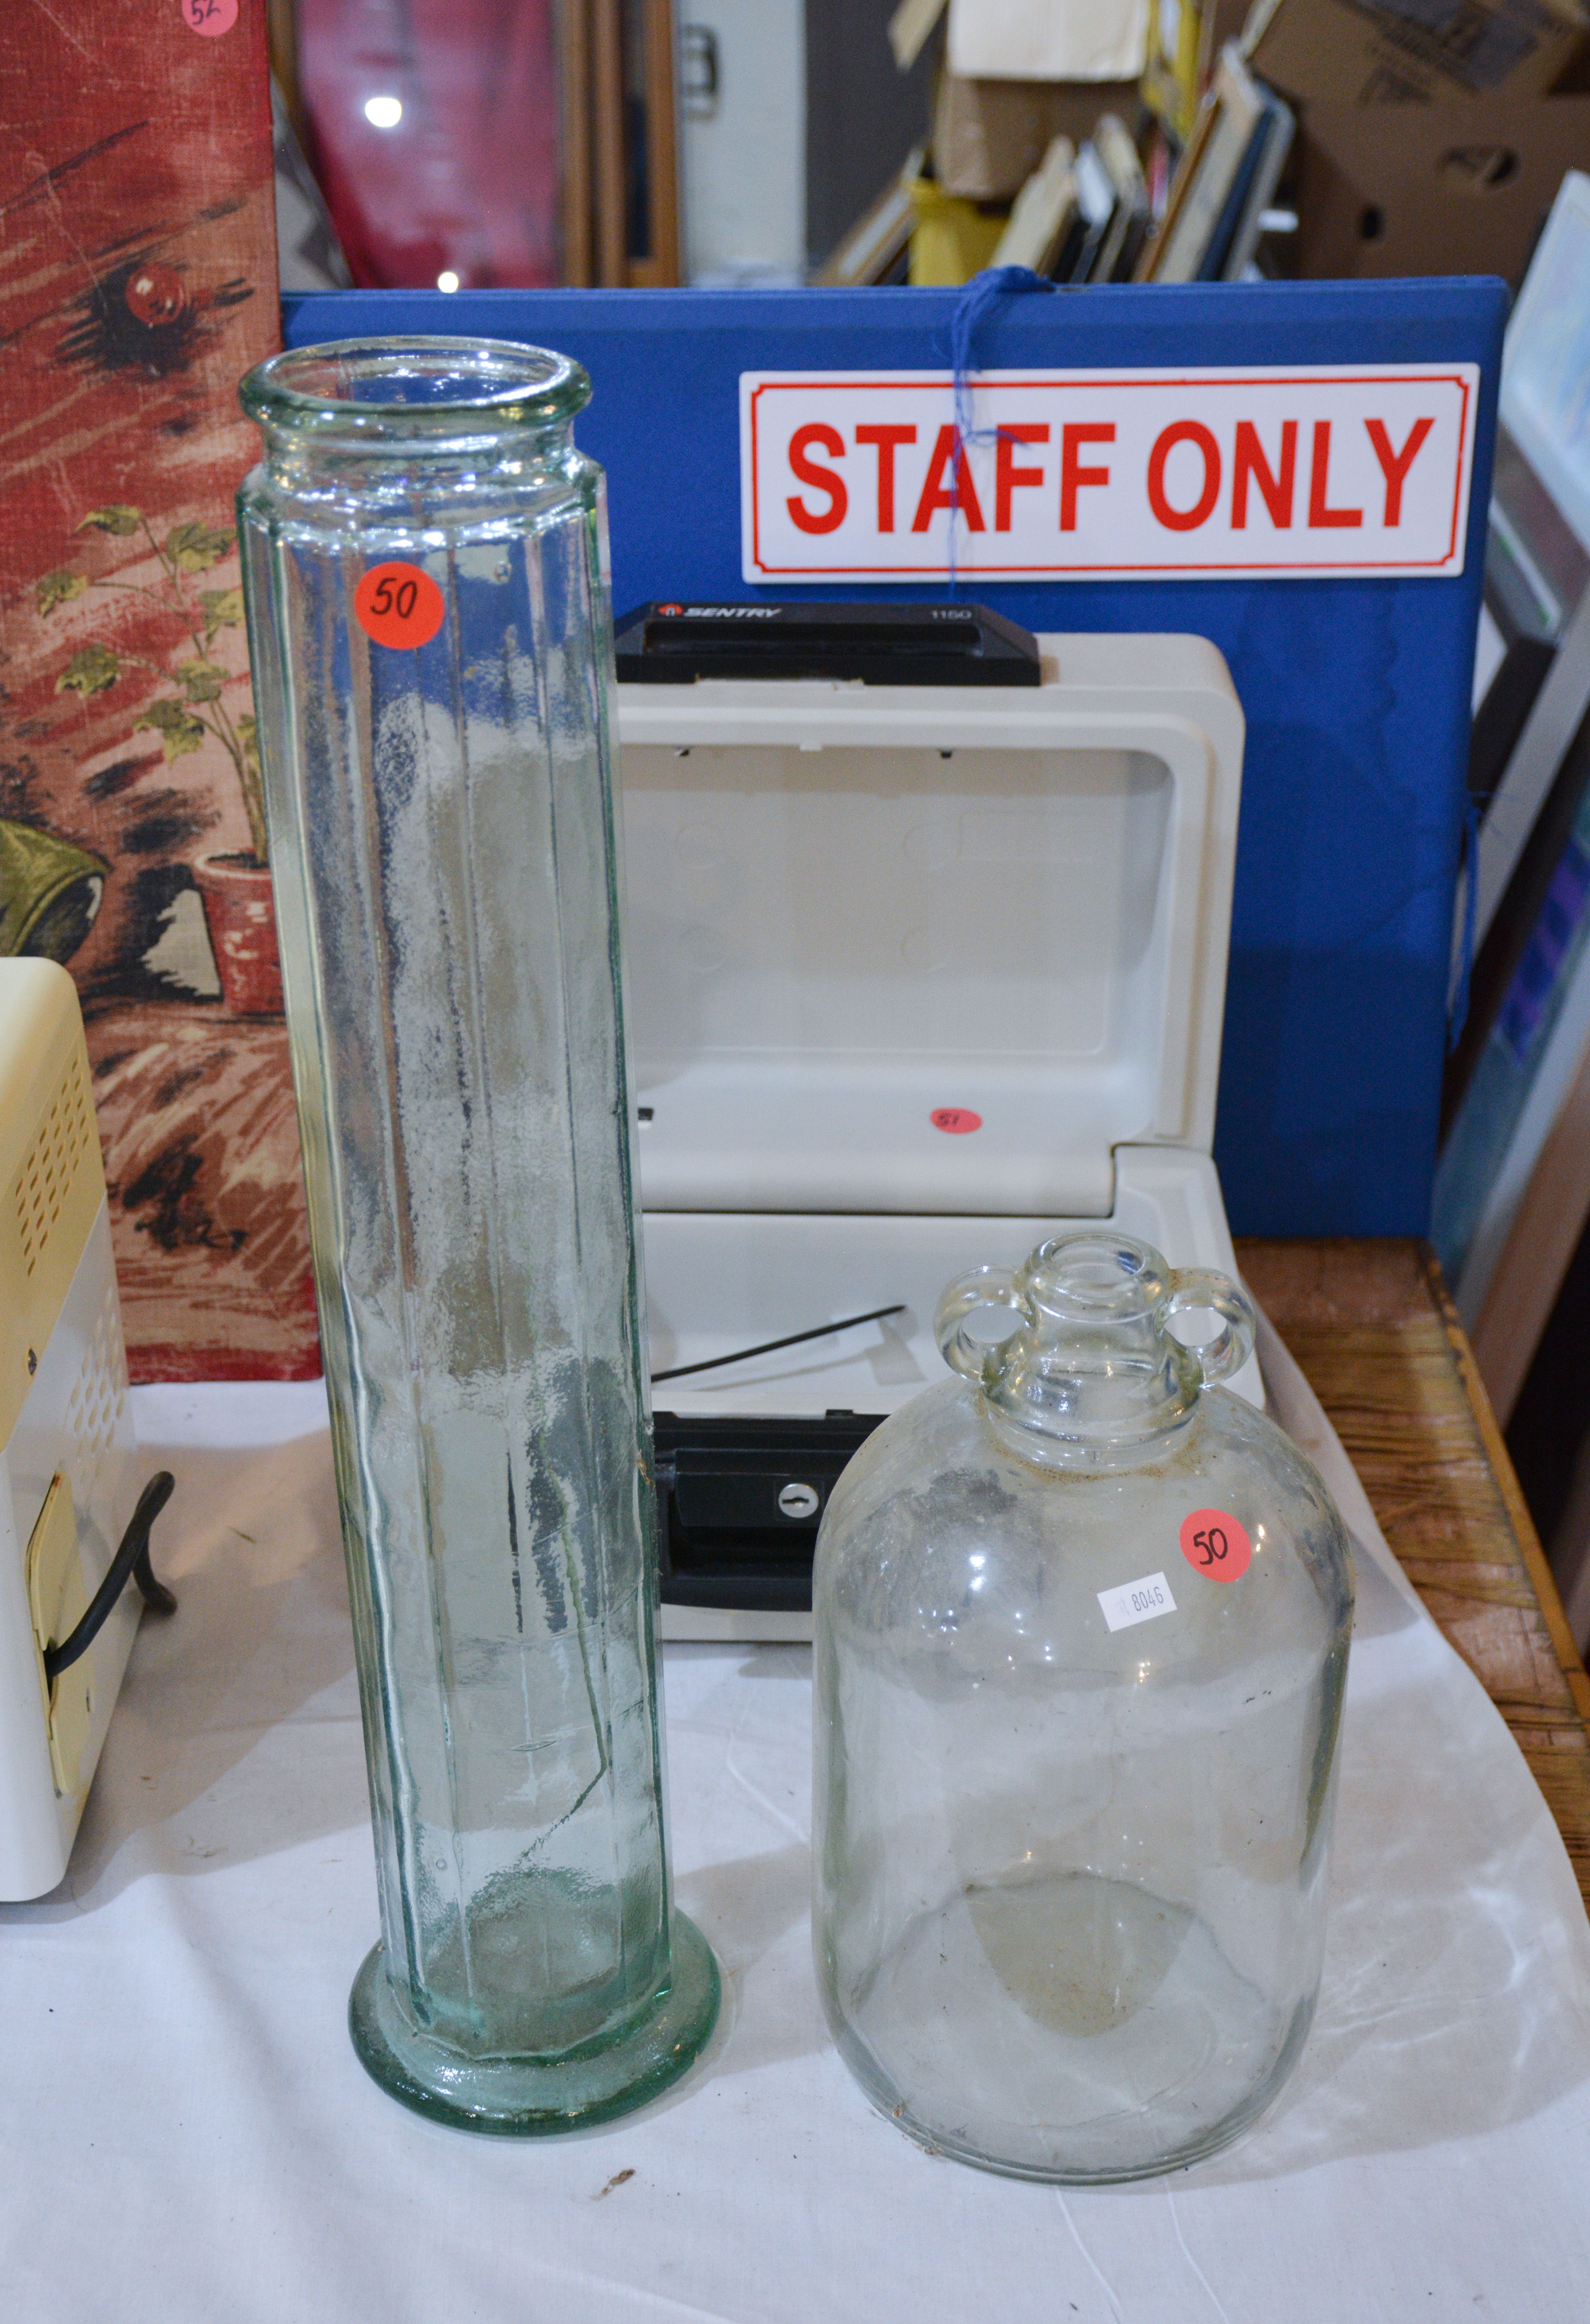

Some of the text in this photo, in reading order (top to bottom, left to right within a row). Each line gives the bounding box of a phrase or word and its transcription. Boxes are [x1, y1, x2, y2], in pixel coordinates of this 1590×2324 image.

[786, 418, 1435, 534] STAFF ONLY
[370, 577, 417, 618] 50
[684, 607, 782, 618] SENTRY
[1193, 1528, 1227, 1565] 50
[1131, 1586, 1164, 1611] 8046
